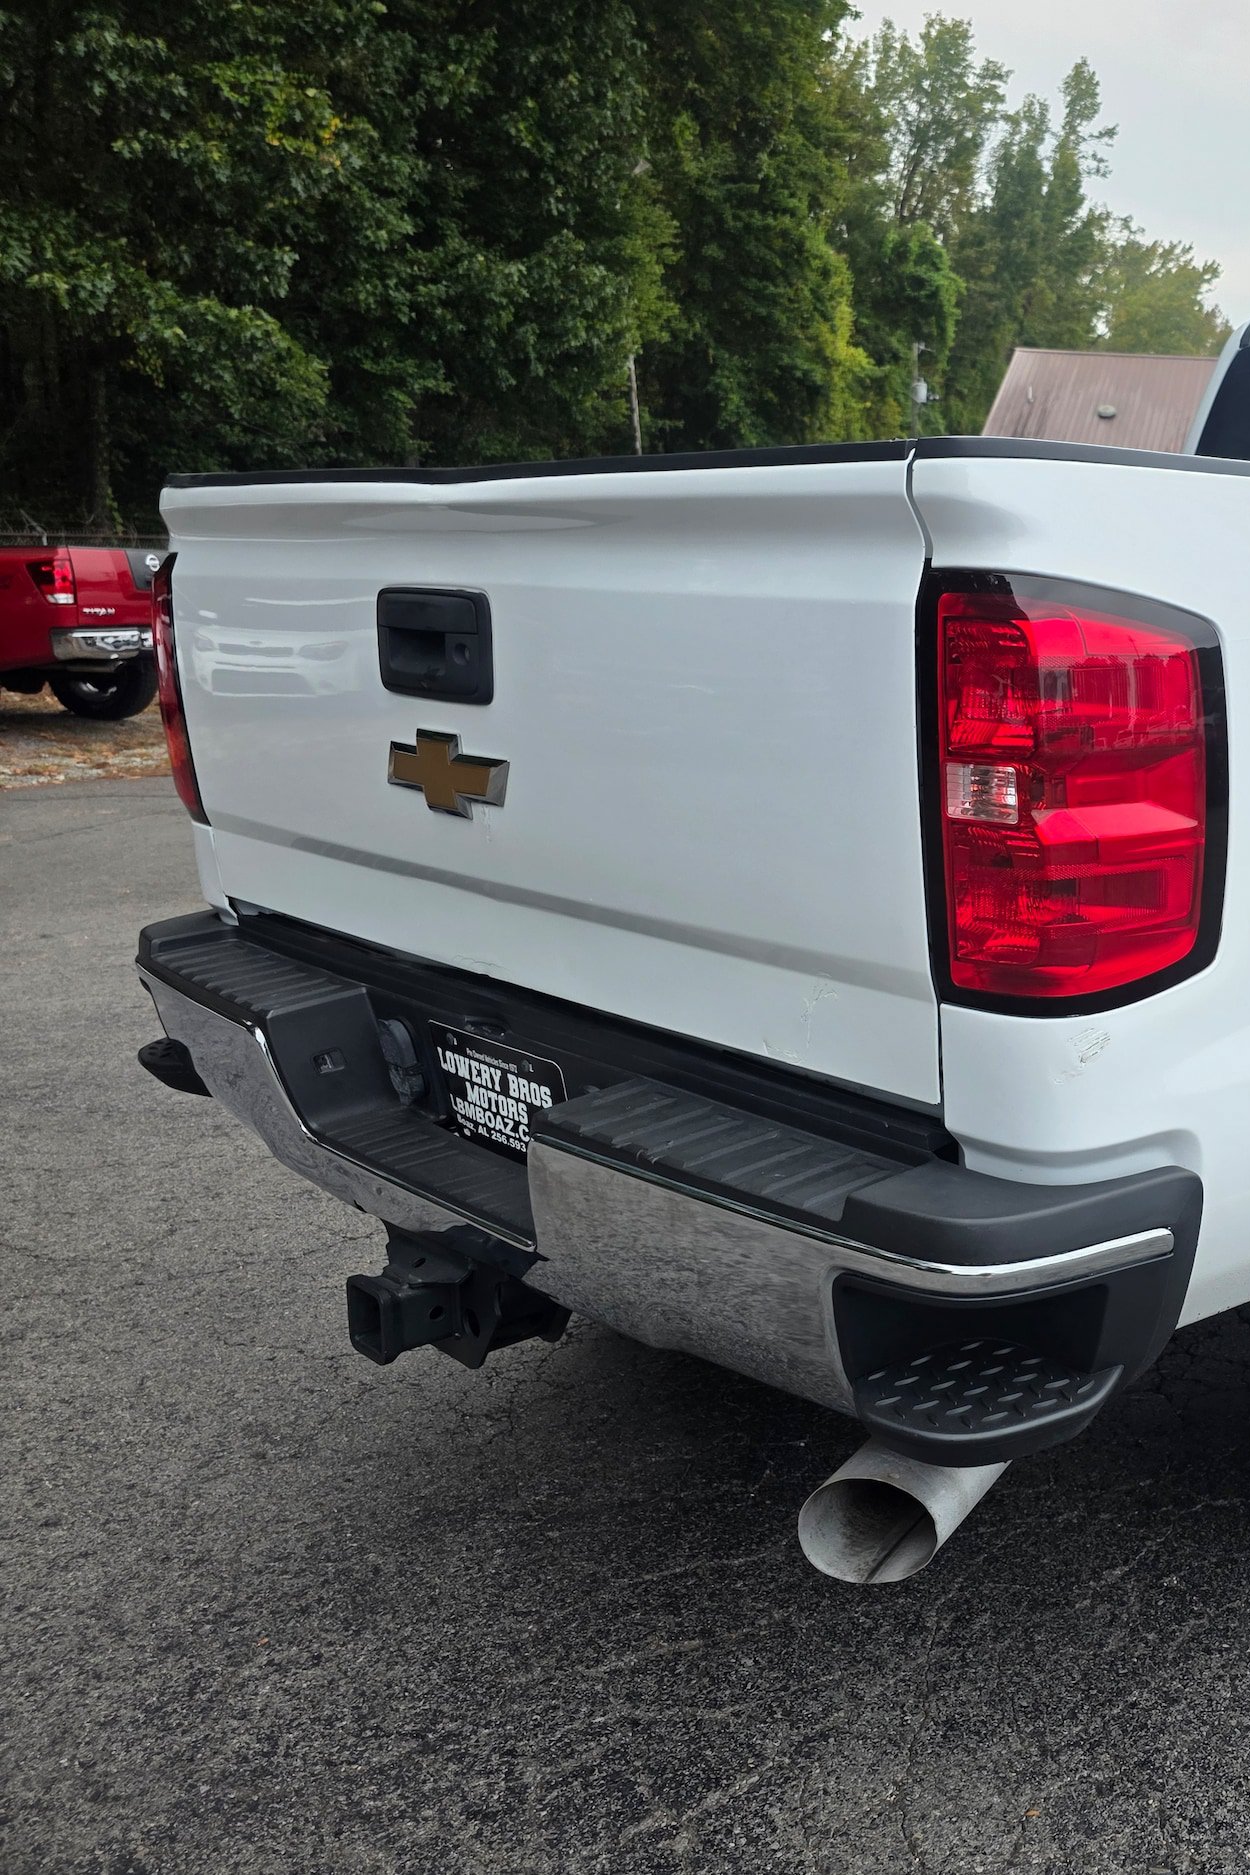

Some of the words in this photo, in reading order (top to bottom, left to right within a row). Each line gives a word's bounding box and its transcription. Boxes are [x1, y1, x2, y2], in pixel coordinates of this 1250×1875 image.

[437, 1046, 501, 1092] LOWERY
[507, 1073, 553, 1109] BROS
[450, 1093, 534, 1142] LBMBOAZ.C
[465, 1081, 528, 1125] MOTORS
[478, 1125, 490, 1137] AL
